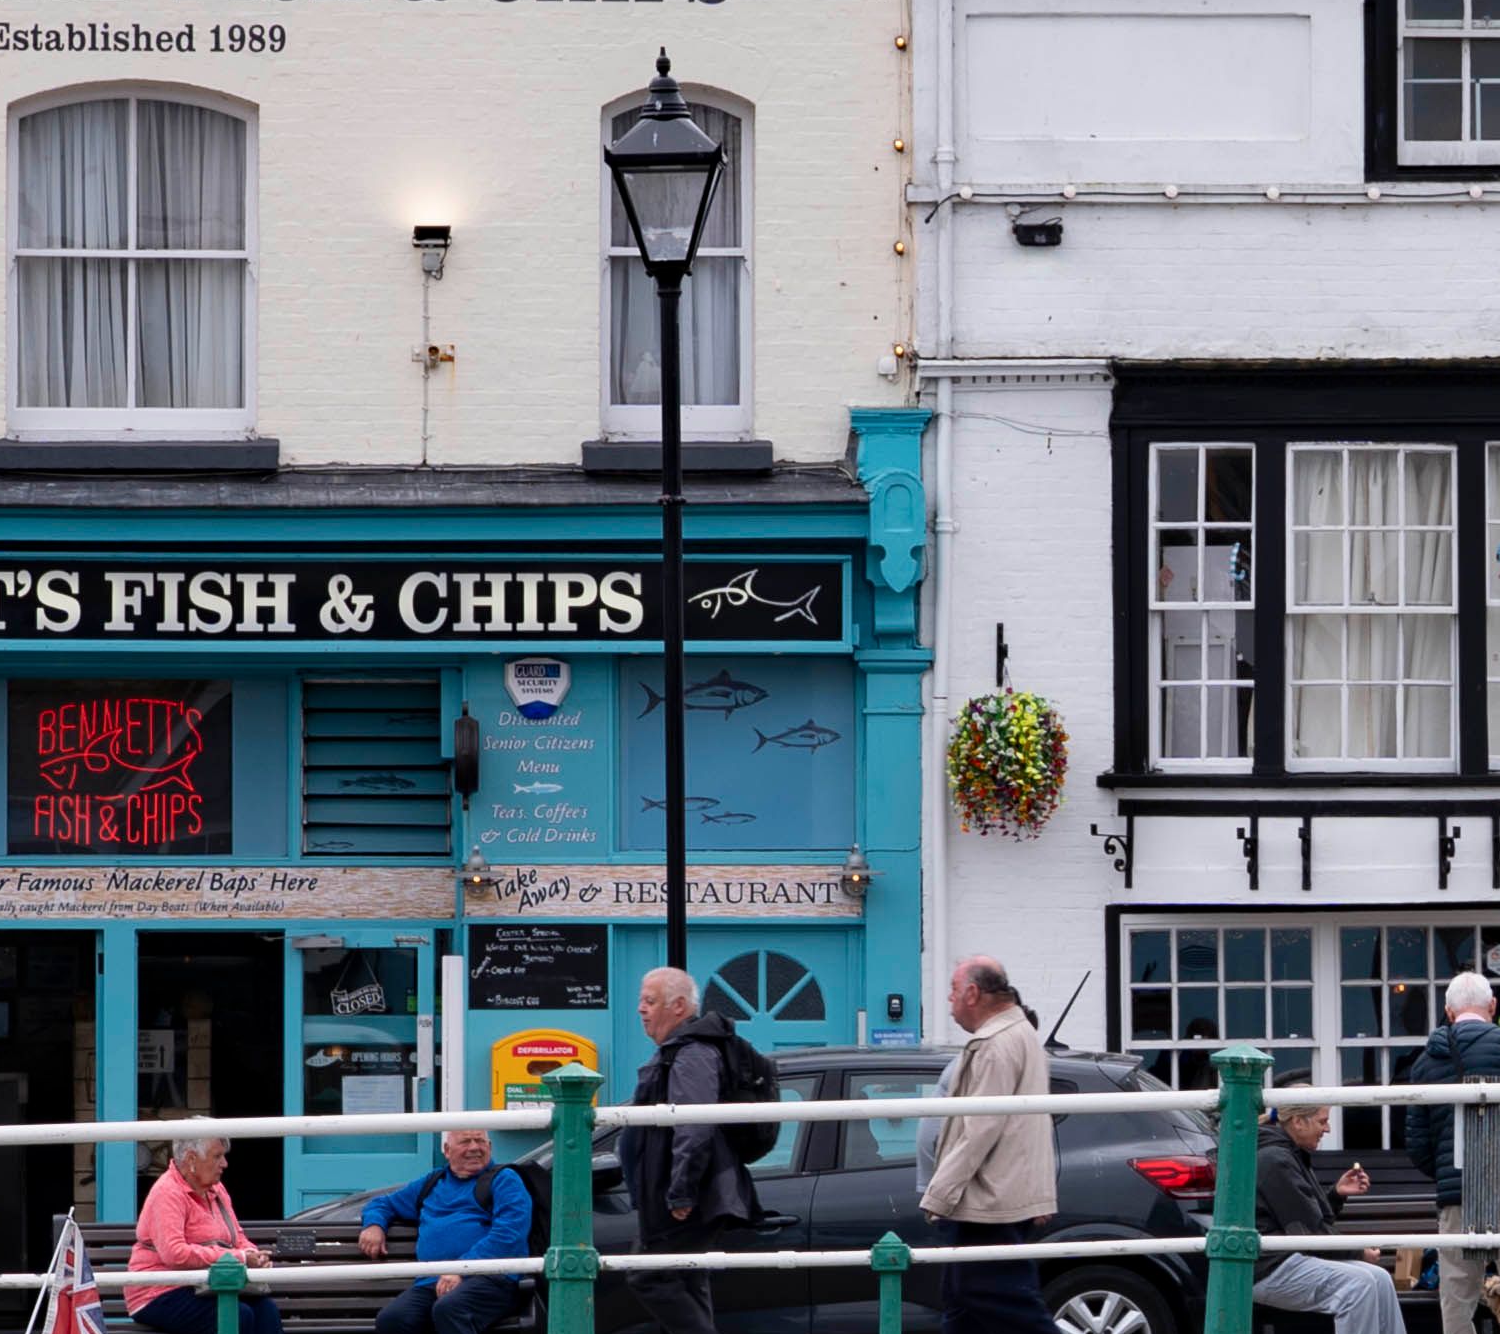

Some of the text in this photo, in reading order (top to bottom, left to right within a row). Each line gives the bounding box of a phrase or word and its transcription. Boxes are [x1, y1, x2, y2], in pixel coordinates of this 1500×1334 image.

[210, 25, 285, 52] 1989
[104, 572, 296, 635] FISH
[320, 574, 374, 633] &
[399, 572, 643, 633] CHIPS
[39, 699, 203, 754] BENNETT'S
[484, 736, 593, 750] Senior Citizens
[518, 761, 559, 773] Menu
[35, 794, 203, 845] FISH & CHIPS
[507, 828, 541, 842] Cold
[545, 828, 596, 842] Drinks
[16, 871, 94, 891] Famous
[271, 873, 318, 891] Here
[490, 867, 539, 902] Take
[517, 873, 570, 913] Away
[19, 902, 54, 915] caught
[58, 901, 108, 912] Mackerel
[108, 900, 133, 915] from
[137, 901, 158, 915] Day
[195, 901, 228, 912] (When
[231, 901, 286, 913] Available)
[337, 993, 380, 1013] CLOSED
